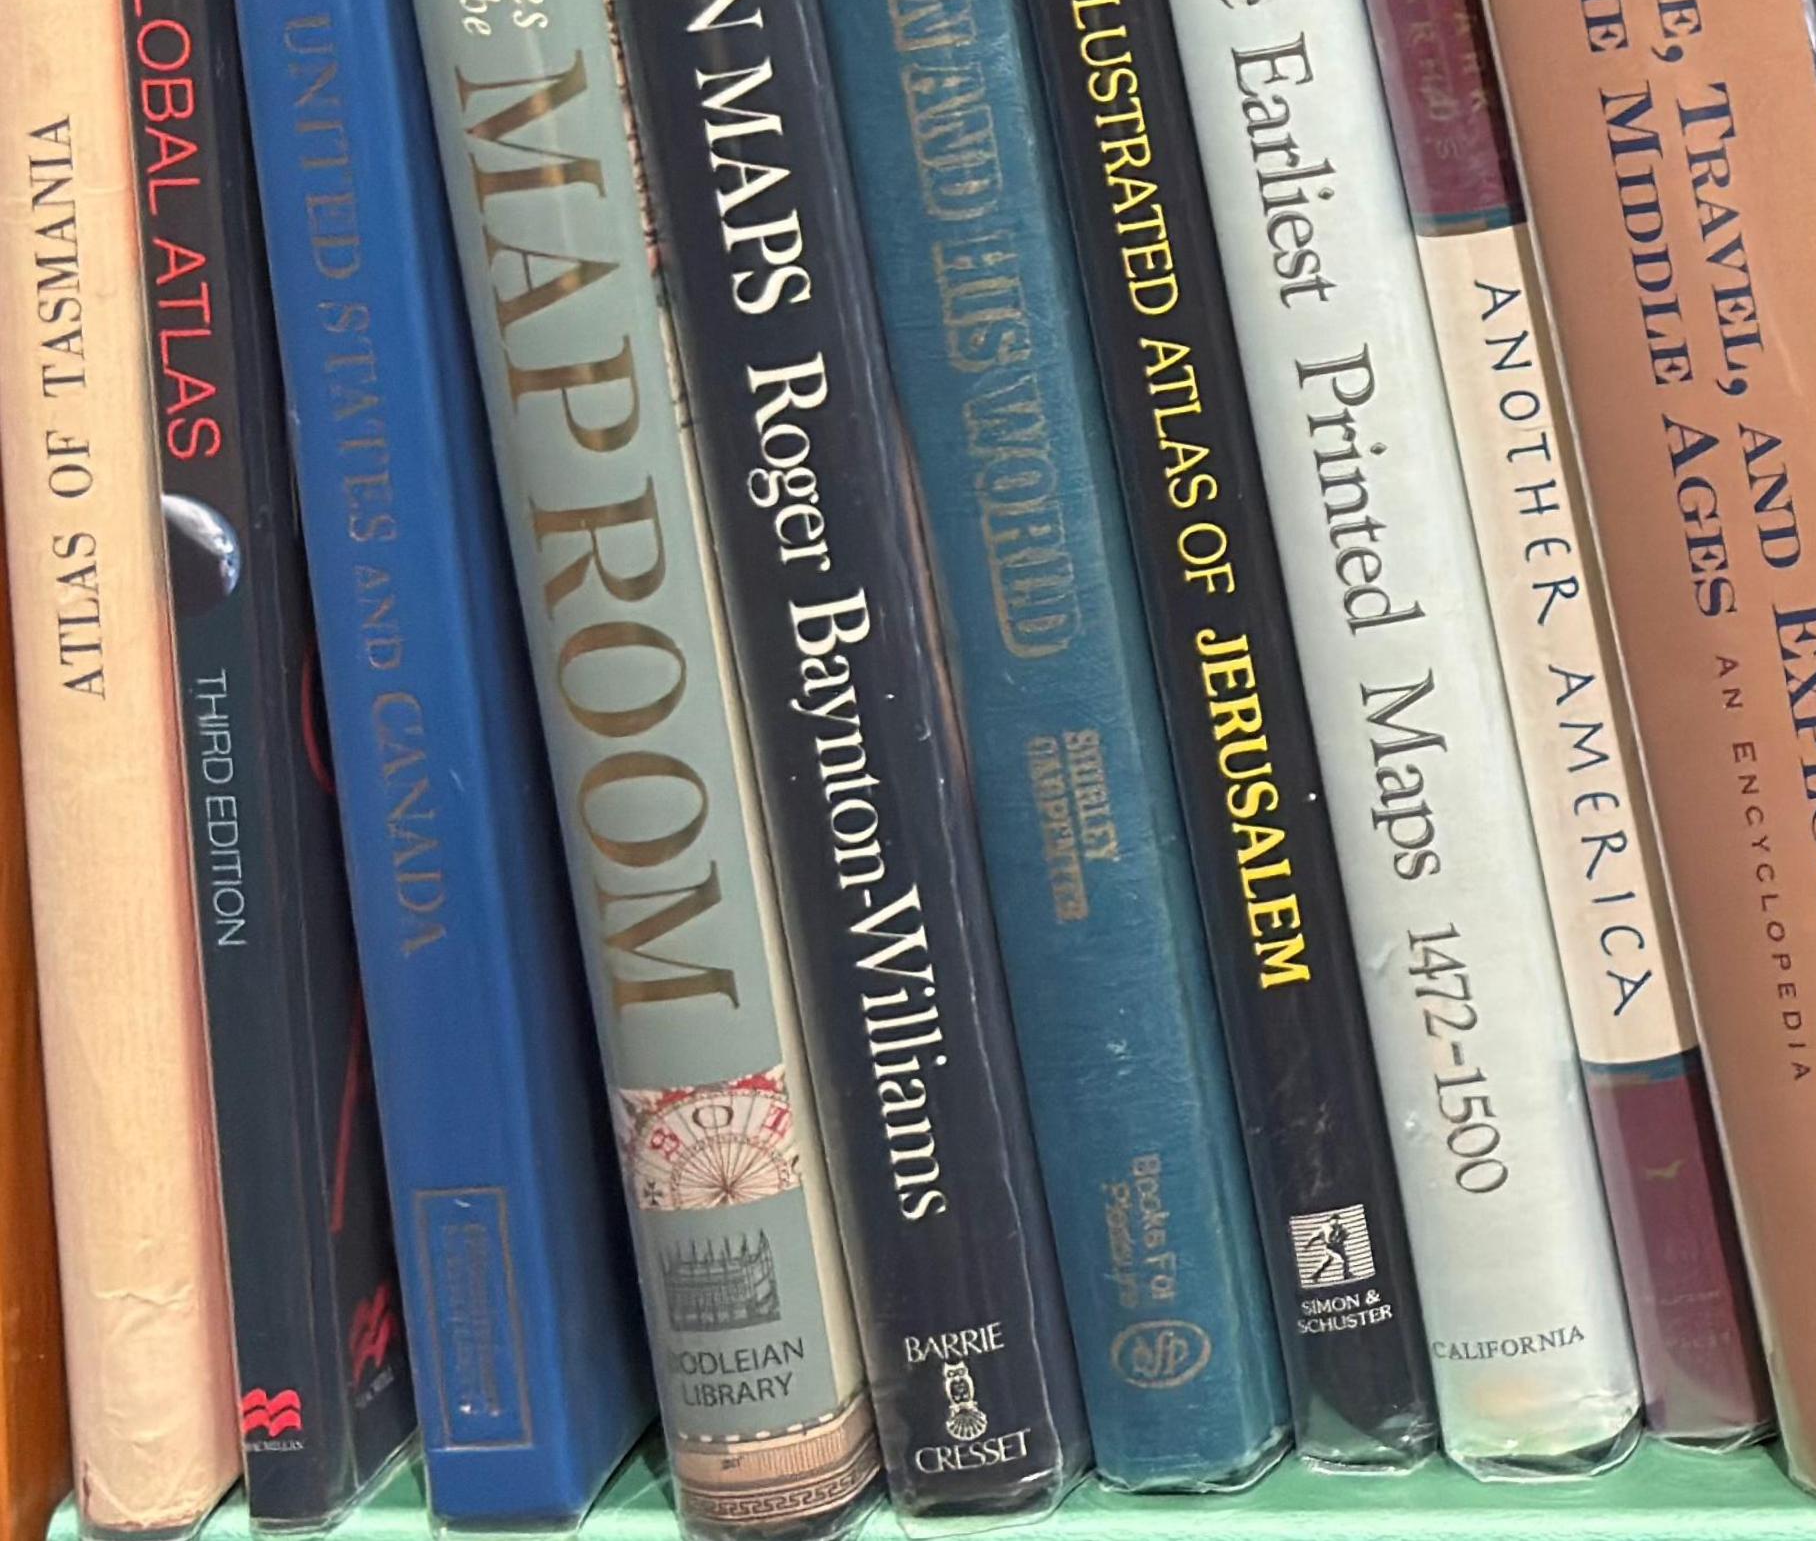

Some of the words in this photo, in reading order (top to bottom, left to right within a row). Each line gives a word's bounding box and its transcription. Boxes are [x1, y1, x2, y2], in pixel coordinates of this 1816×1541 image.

[284, 14, 361, 280] UNITED
[696, 57, 811, 316] MAPS
[902, 61, 1002, 225] AND
[1231, 31, 1336, 309] Earliest
[28, 115, 86, 397] TASMANIA
[153, 237, 221, 460] ATLAS
[931, 227, 1031, 374] HIS
[1677, 80, 1765, 397] TRAVEL,
[1737, 422, 1803, 569] AND
[47, 429, 94, 499] OF
[318, 300, 398, 545] STATES
[744, 351, 831, 574] Roger
[959, 374, 1082, 659] WORLD
[1139, 337, 1219, 509] ATLAS
[1296, 342, 1426, 639] Printed
[52, 532, 105, 700] ATLAS
[353, 563, 403, 670] AND
[1176, 522, 1236, 594] OF
[1474, 278, 1580, 627] ANOTHER
[1548, 662, 1652, 1017] AMERICA
[1599, 80, 1694, 387] MIDDLE
[1661, 413, 1739, 618] AGES
[1714, 655, 1743, 709] AN
[1732, 741, 1812, 1080] ENCYCLOPEDIA
[197, 669, 233, 785] THIRD
[372, 691, 448, 956] CANADA
[1194, 626, 1312, 992] JERUSALEM
[1359, 667, 1443, 883] Maps
[205, 794, 247, 949] EDITION
[789, 587, 948, 1224] Baynton-Williams
[1406, 921, 1510, 1196] 1472-1500
[681, 1371, 793, 1408] LIBRARY
[905, 1322, 1005, 1363] BARRIE
[1297, 1303, 1392, 1335] SCHUSTER
[1300, 1294, 1362, 1318] SIMON
[1363, 1288, 1382, 1306] &
[1433, 1323, 1585, 1361] CALIFORNIA
[914, 1427, 1031, 1475] CRESSET
